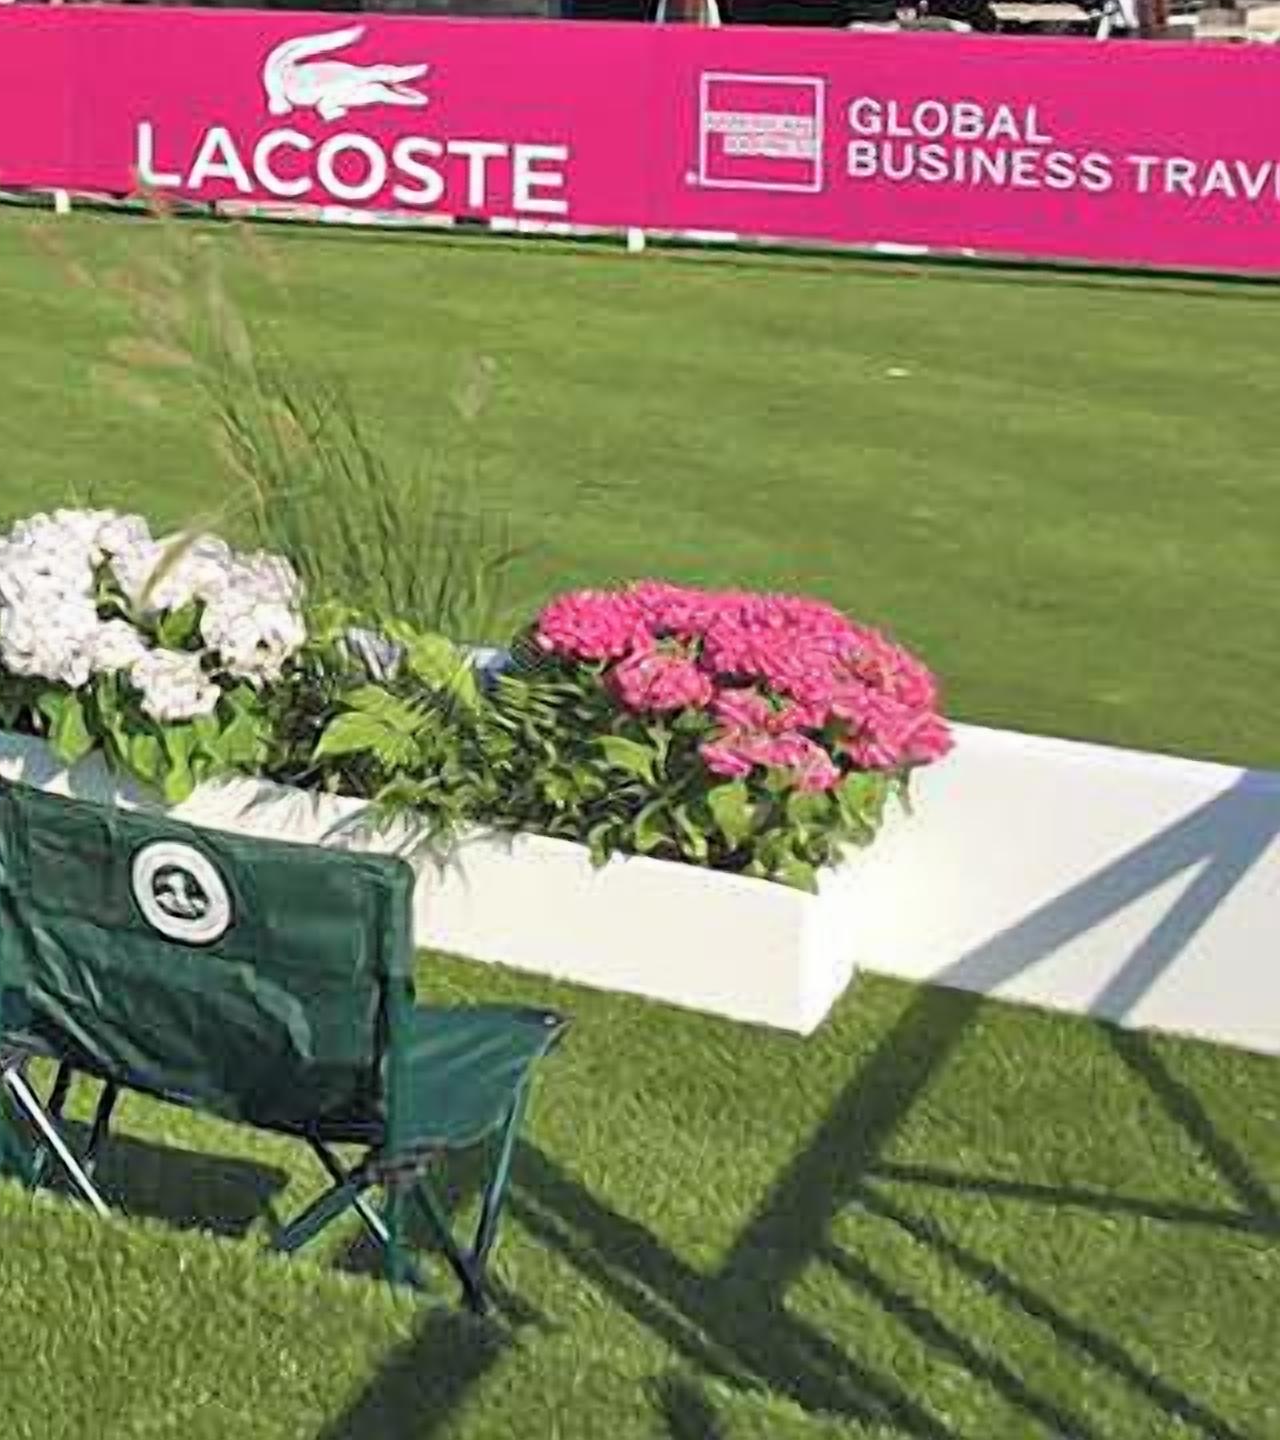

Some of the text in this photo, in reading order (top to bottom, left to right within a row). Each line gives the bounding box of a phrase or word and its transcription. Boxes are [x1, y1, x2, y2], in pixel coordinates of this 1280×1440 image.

[848, 97, 1053, 145] GLOBAL
[138, 122, 569, 215] LACOSTE
[847, 140, 1114, 193] BUSINESS
[1126, 155, 1280, 201] TRAV
